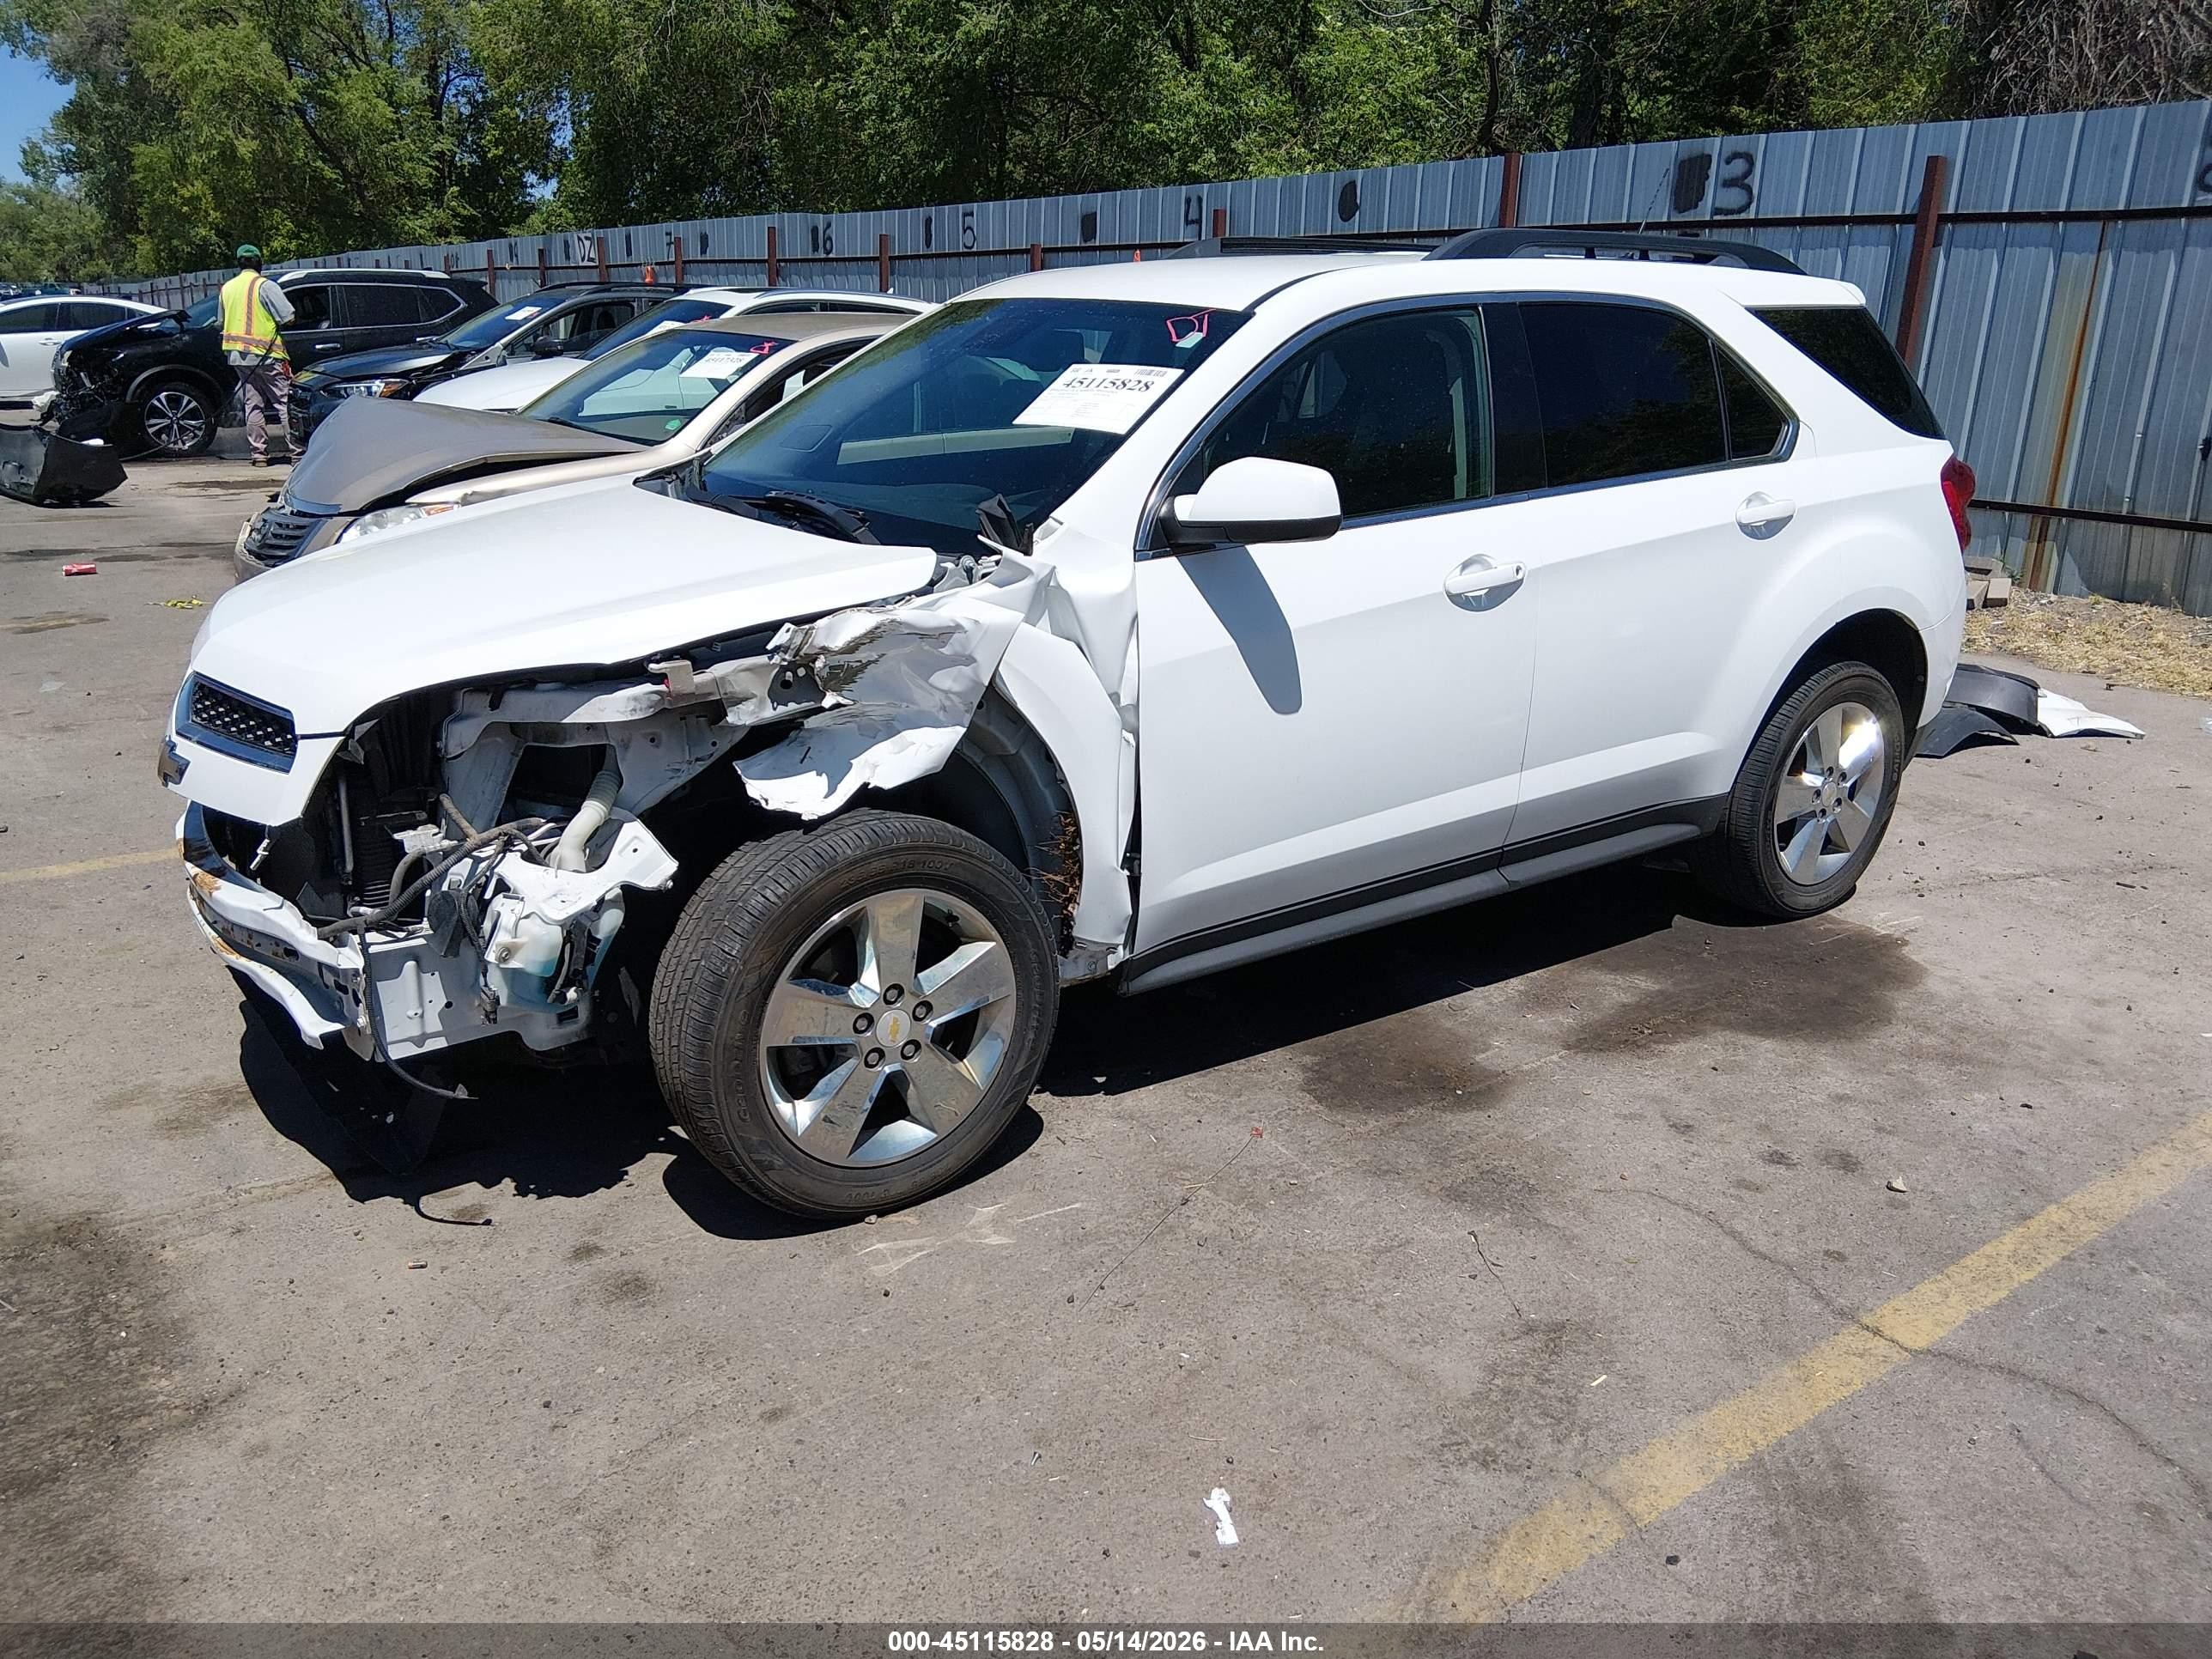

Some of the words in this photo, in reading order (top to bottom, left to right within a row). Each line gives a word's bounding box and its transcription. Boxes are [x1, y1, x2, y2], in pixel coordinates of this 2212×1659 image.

[1714, 152, 1754, 216] 3
[962, 211, 976, 250] 5
[1185, 195, 1203, 240] 4
[822, 220, 834, 256] 6
[1062, 378, 1155, 392] 45115828
